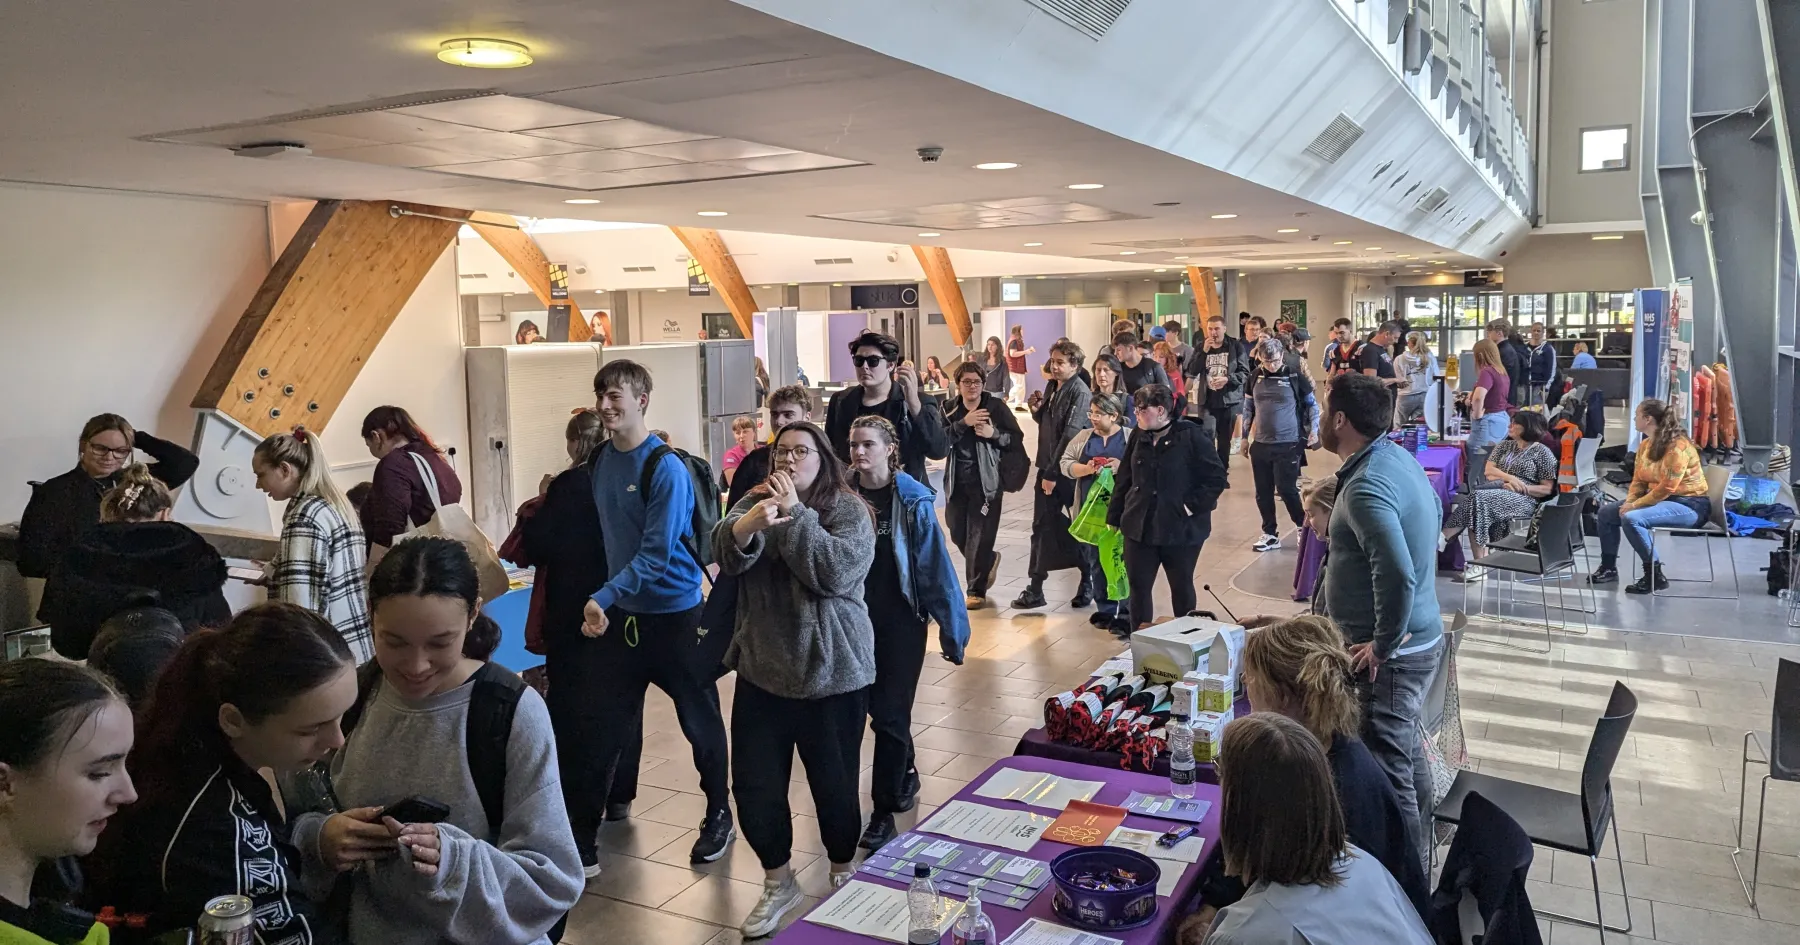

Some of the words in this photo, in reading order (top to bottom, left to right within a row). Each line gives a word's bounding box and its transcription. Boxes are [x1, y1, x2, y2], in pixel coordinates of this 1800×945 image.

[1644, 312, 1655, 322] NHS
[1143, 666, 1178, 680] WELLBEING
[1020, 826, 1038, 838] NHS
[256, 886, 269, 894] XIX
[1080, 906, 1104, 918] HEROES
